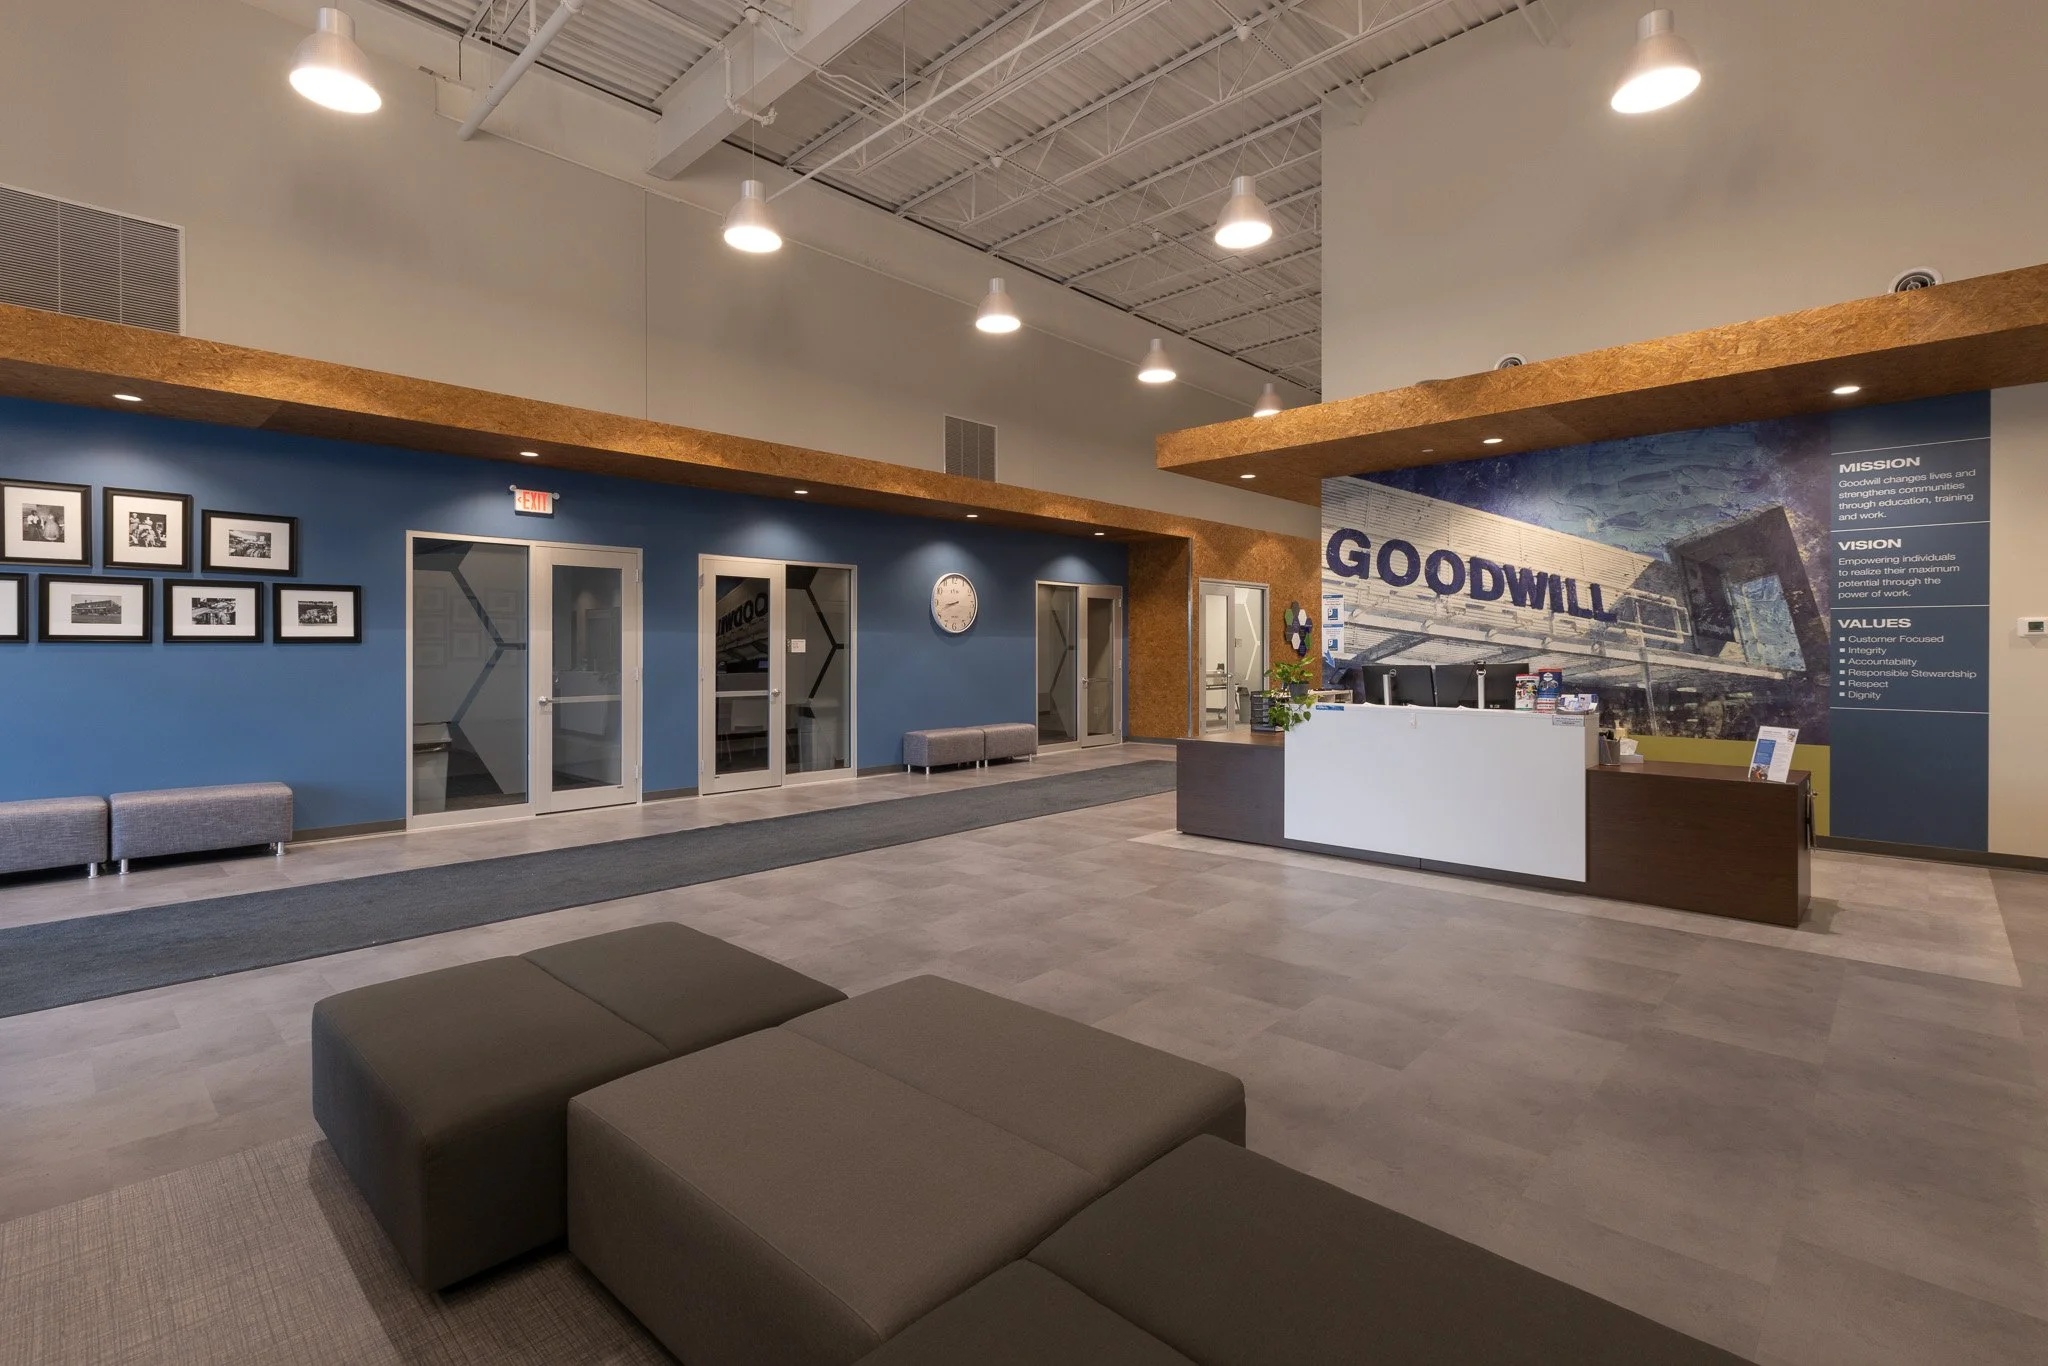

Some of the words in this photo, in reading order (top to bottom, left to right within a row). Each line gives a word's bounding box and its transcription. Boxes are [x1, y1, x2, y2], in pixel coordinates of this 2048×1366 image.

[1839, 457, 1920, 473] MISSION
[1838, 478, 1880, 488] Goodwill
[1883, 474, 1927, 484] changes
[1930, 471, 1952, 480] lives
[1955, 469, 1976, 478] and
[1838, 488, 1896, 498] strengthens
[1898, 482, 1966, 494] communities
[522, 491, 548, 511] EXIT
[1838, 500, 1876, 510] through
[1878, 497, 1932, 506] education,
[1934, 494, 1974, 502] training
[1838, 512, 1858, 520] and
[1860, 511, 1886, 520] work.
[1838, 538, 1902, 550] VISION
[1838, 556, 1900, 566] Empowering
[1902, 553, 1956, 562] individuals
[1326, 527, 1618, 624] GOODWILL
[1850, 568, 1882, 576] realize
[1884, 566, 1906, 574] their
[1908, 564, 1960, 574] maximum
[1838, 578, 1880, 588] potential
[1882, 578, 1921, 586] through
[1838, 591, 1868, 600] power
[1871, 590, 1882, 598] of
[1884, 589, 1912, 597] work.
[1838, 618, 1912, 628] VALUES
[1900, 635, 1944, 643] Focused
[1848, 647, 1887, 656] Integrity
[1848, 658, 1917, 668] Accountability
[1848, 668, 1909, 678] Responsible
[1911, 669, 1978, 680] Stewardship
[1848, 680, 1889, 688] Respect
[1848, 690, 1882, 700] Dignity
